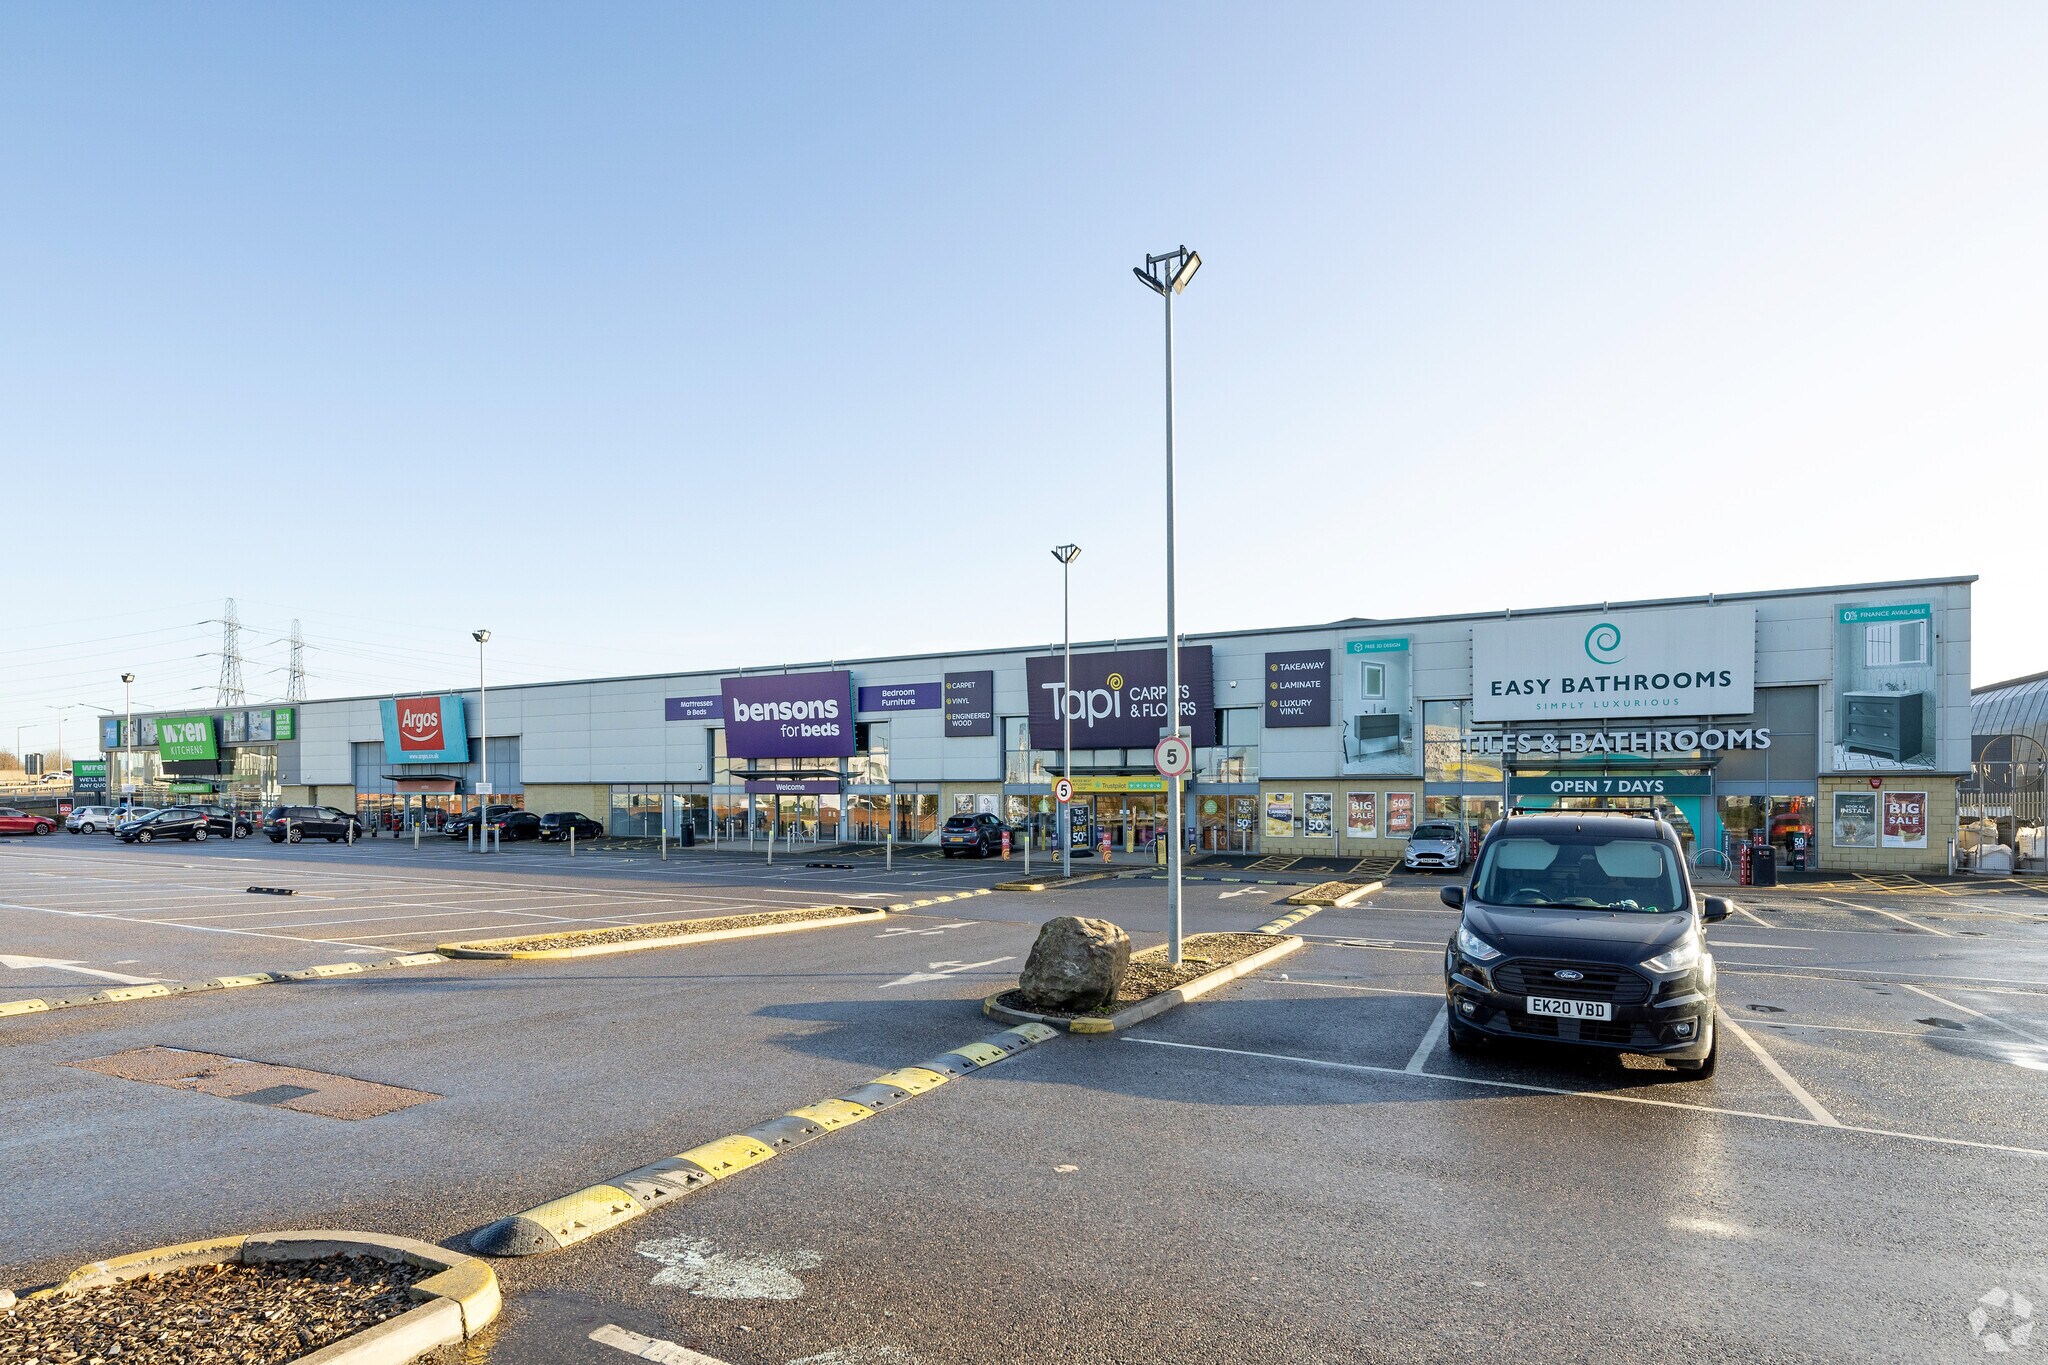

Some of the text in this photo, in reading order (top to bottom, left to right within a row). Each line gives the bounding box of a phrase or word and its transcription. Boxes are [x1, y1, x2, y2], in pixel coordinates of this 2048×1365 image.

[1891, 608, 1925, 616] AVAILABLE
[1279, 662, 1325, 671] TAKEAWAY
[952, 681, 976, 689] CARPET
[1279, 680, 1321, 689] LAMINATE
[1491, 670, 1732, 696] EASY BATHROOMS
[881, 689, 915, 697] Bedroom
[1129, 685, 1190, 701] CARPS
[680, 700, 713, 708] Mattresses
[881, 698, 916, 706] Furniture
[1041, 672, 1124, 729] Tapi
[1279, 699, 1312, 707] LUXURY
[1536, 698, 1679, 710] SIMPLY LUXURIOUS
[733, 697, 839, 722] bensons
[1130, 701, 1197, 718] & FLORS
[1279, 707, 1304, 715] VINYL
[402, 708, 438, 733] Argos
[952, 712, 991, 720] ENGINEERED
[162, 722, 207, 743] wren
[780, 722, 840, 737] for beds
[1460, 728, 1772, 755] TILES & BATHROOMS
[170, 745, 203, 755] KITCHENS
[1166, 749, 1178, 765] 5
[775, 783, 806, 791] Welcome
[1060, 784, 1068, 797] 5
[1550, 779, 1664, 793] OPEN 7 DAYS
[1351, 801, 1372, 811] BIG
[1889, 803, 1919, 814] BIG
[1889, 816, 1919, 825] SALE
[1533, 999, 1605, 1018] EK20 VBD
